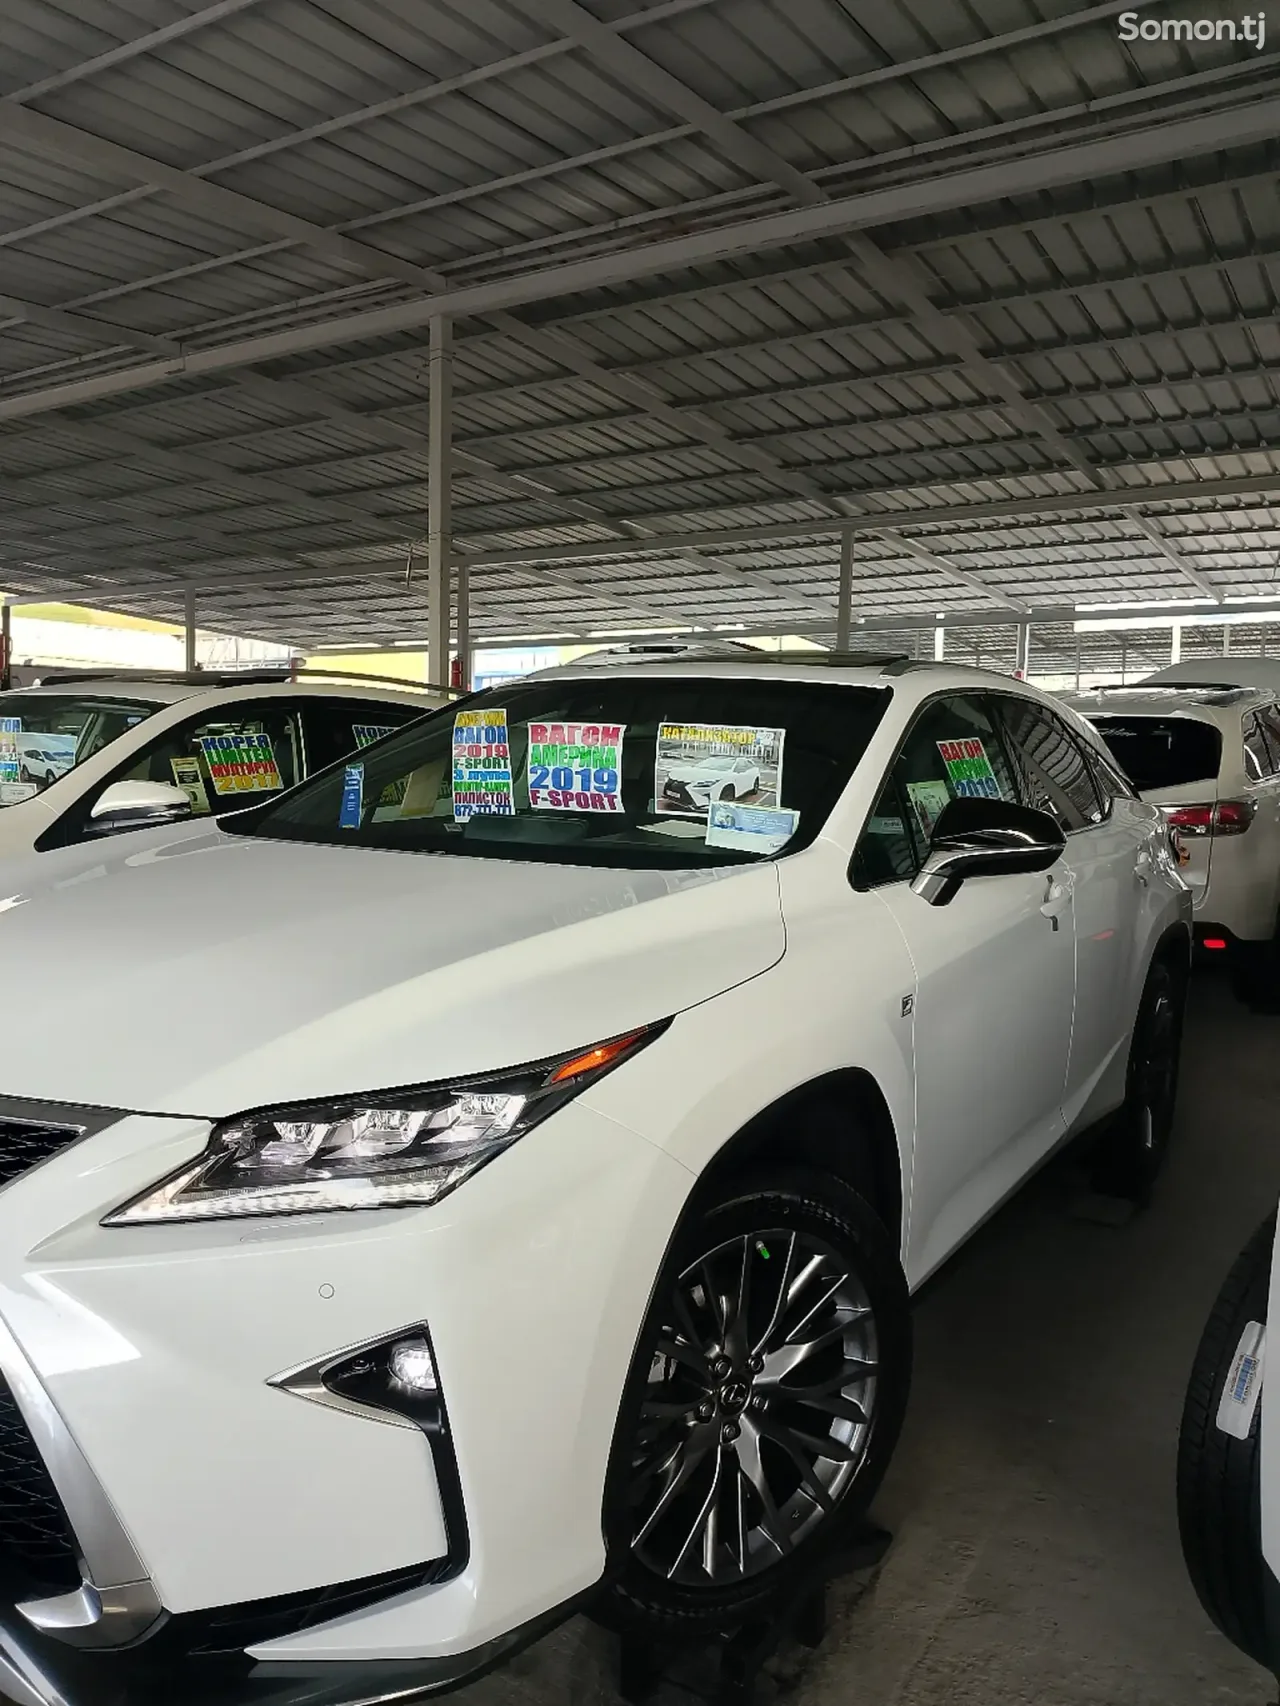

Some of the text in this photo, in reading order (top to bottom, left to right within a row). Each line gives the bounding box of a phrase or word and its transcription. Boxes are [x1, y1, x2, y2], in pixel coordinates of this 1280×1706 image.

[202, 735, 270, 750] КОРЕЯ
[454, 726, 507, 744] ВАГОН
[529, 725, 620, 746] ВАГОН
[454, 744, 508, 758] 2019
[530, 744, 617, 768] АМЕРИКА
[939, 740, 984, 761] ВАГОН
[454, 757, 508, 769] F-SPORT
[216, 772, 280, 791] 2017
[454, 769, 464, 780] 3
[530, 765, 618, 794] 2019
[530, 789, 617, 810] F-SPORT
